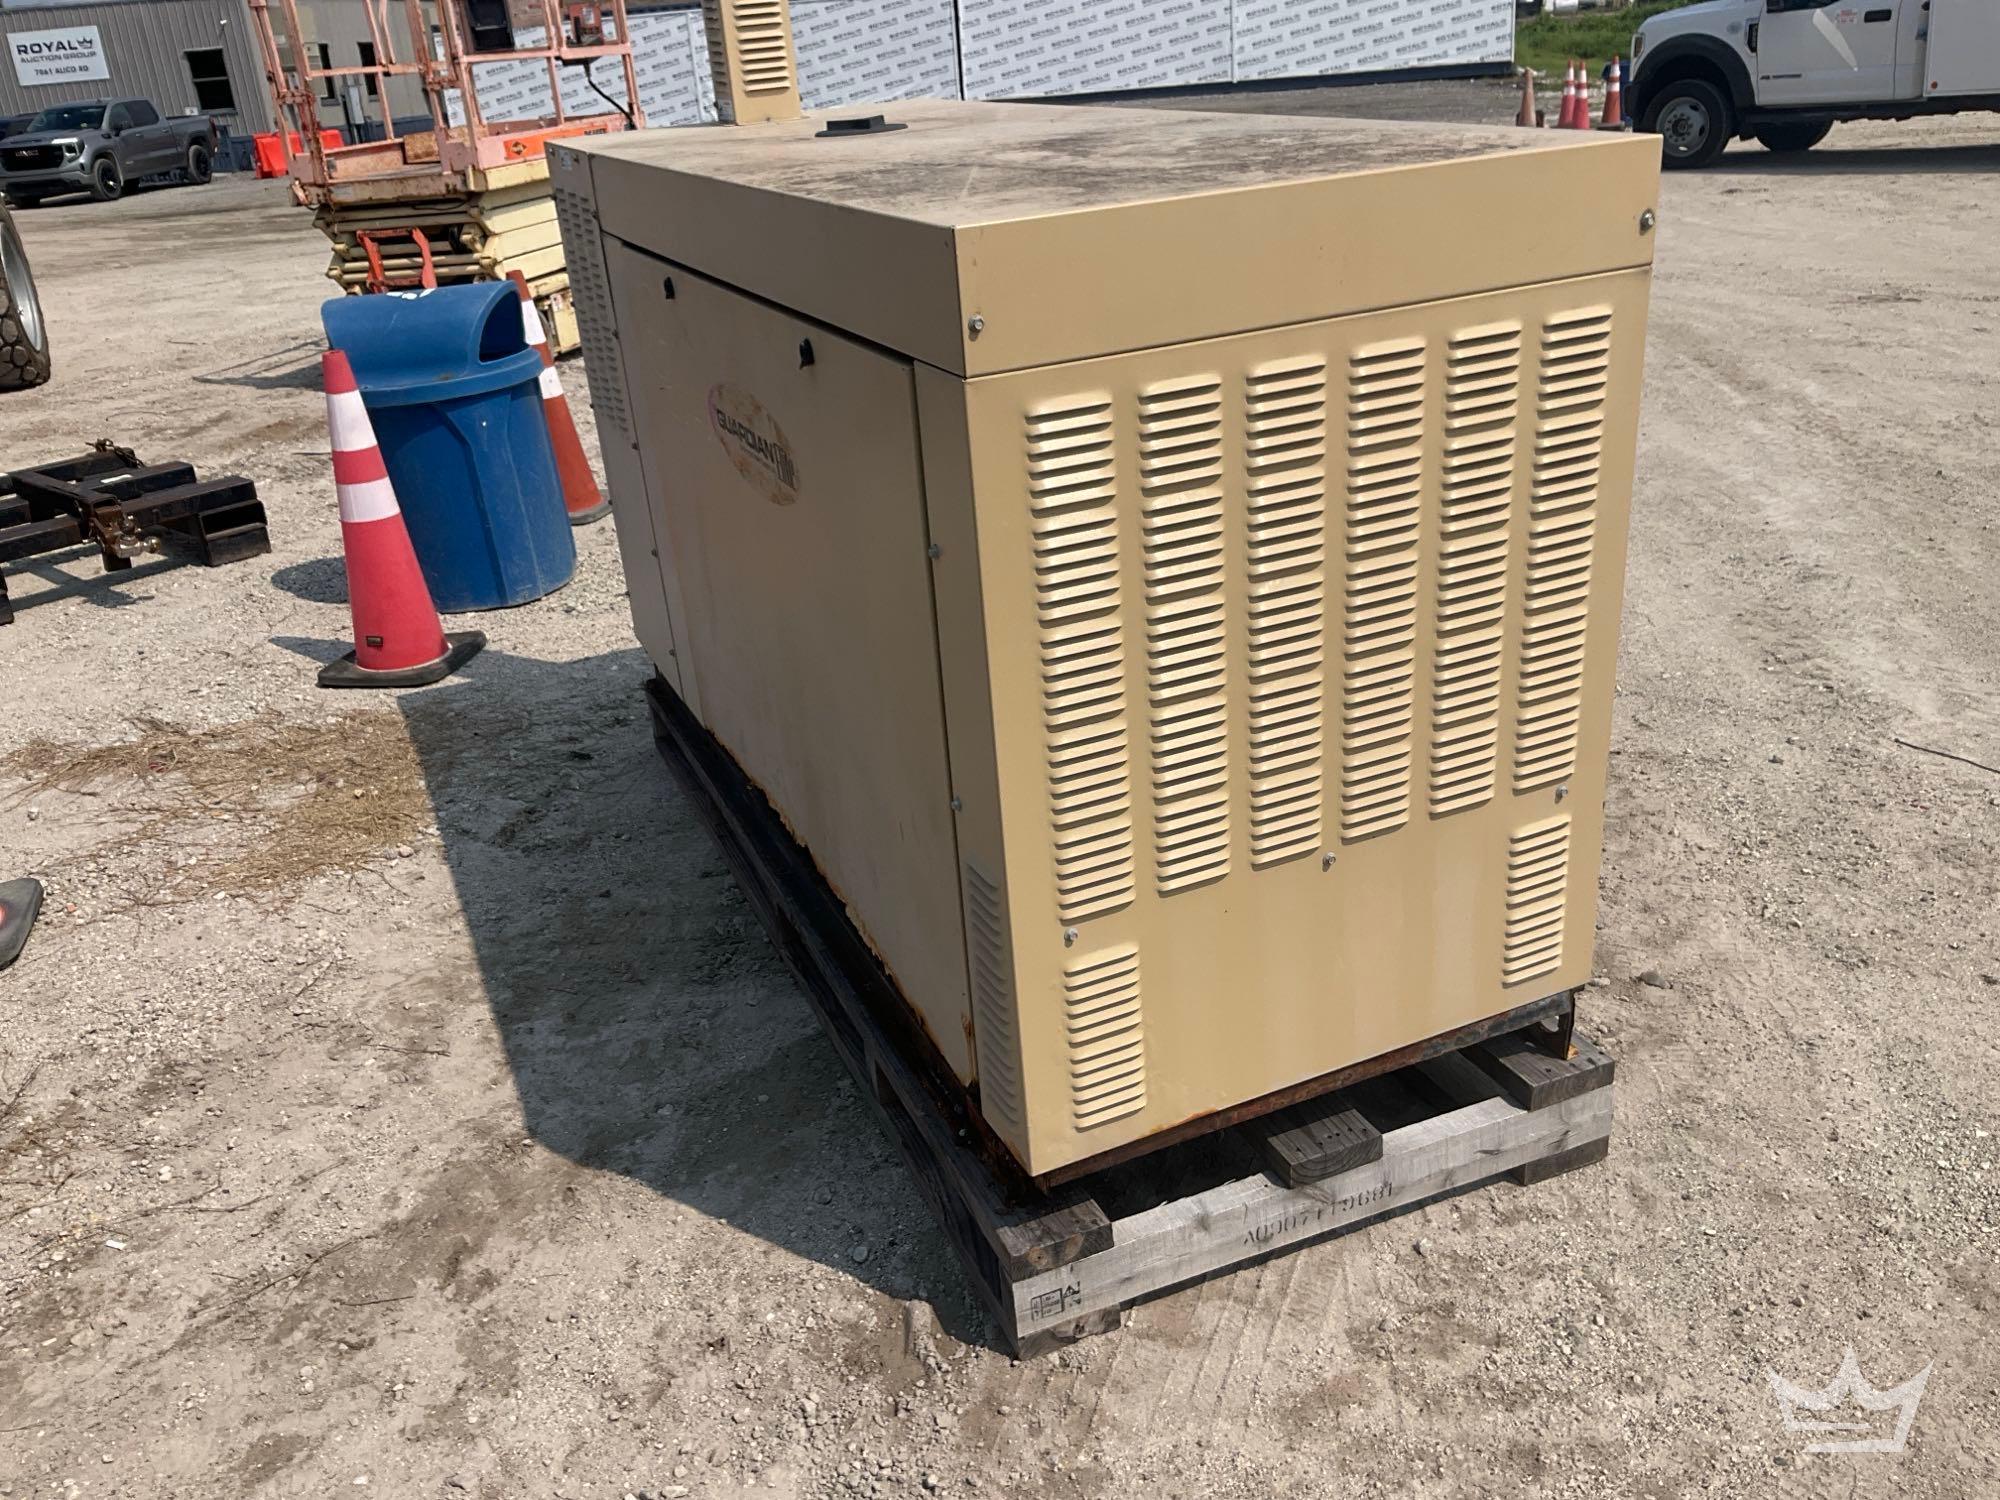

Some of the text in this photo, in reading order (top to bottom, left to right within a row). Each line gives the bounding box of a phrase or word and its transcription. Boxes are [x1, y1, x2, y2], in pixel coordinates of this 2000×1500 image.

[16, 40, 78, 55] ROYAL
[21, 51, 96, 63] AUCTION GROUP
